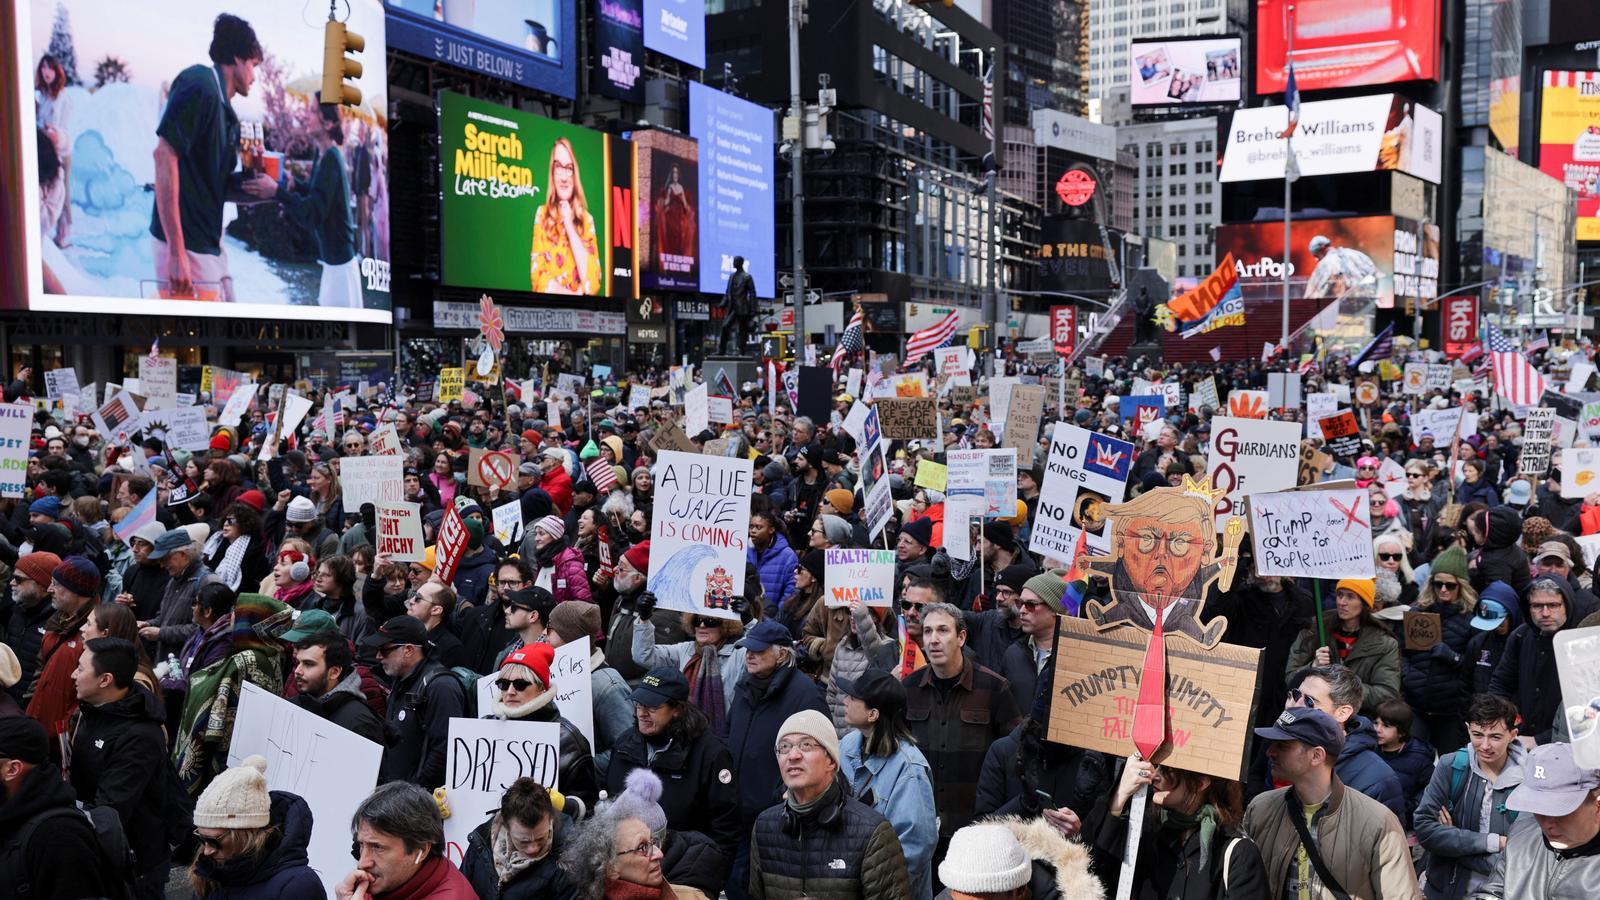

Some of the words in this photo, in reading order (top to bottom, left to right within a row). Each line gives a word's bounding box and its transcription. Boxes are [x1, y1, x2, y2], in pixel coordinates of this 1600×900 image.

[447, 42, 474, 66] JUST
[477, 51, 514, 78] BELOW
[1237, 126, 1293, 143] Breho
[1302, 119, 1375, 136] Williams
[464, 123, 523, 160] Sarah
[455, 149, 533, 188] Millican
[455, 174, 488, 196] Late
[488, 176, 540, 198] Bloomer
[1057, 243, 1088, 258] THE
[1235, 257, 1295, 280] ArtPop
[678, 301, 696, 312] BLUE
[698, 303, 710, 313] FIN
[1055, 308, 1073, 344] tkts
[1450, 299, 1472, 341] tkts
[638, 329, 658, 339] HEYTEA
[944, 354, 958, 363] ICE
[1015, 390, 1034, 402] ALL
[894, 417, 913, 426] ARE
[916, 416, 935, 427] ALL
[1527, 420, 1548, 430] STAND
[881, 426, 938, 438] ALESTINIANS
[1052, 441, 1078, 459] NO
[1215, 428, 1297, 462] GUARDIANS
[0, 458, 27, 471] RDS
[948, 452, 971, 460] HANDS
[661, 464, 679, 491] A
[688, 464, 748, 497] BLUE
[1047, 462, 1088, 483] KINGS
[391, 509, 411, 517] RICH
[669, 494, 737, 524] WAVE
[1039, 501, 1065, 521] NO
[1214, 496, 1247, 517] PED
[379, 517, 399, 536] GHT
[442, 508, 462, 552] ICE!
[659, 521, 676, 538] IS
[682, 522, 744, 551] COMING
[1036, 523, 1075, 543] FILTHY
[379, 537, 414, 555] ARCHY
[1034, 535, 1070, 554] LUCRE
[1262, 536, 1298, 549] care
[1312, 530, 1330, 548] for
[827, 549, 895, 566] HEALTHCARE
[848, 567, 869, 579] not
[832, 586, 884, 603] WARFARE
[1414, 618, 1428, 629] NO
[1060, 665, 1142, 708] TRUMPTY
[1167, 673, 1233, 729] UMPTY
[452, 737, 558, 793] DRESSED
[1534, 765, 1546, 779] R
